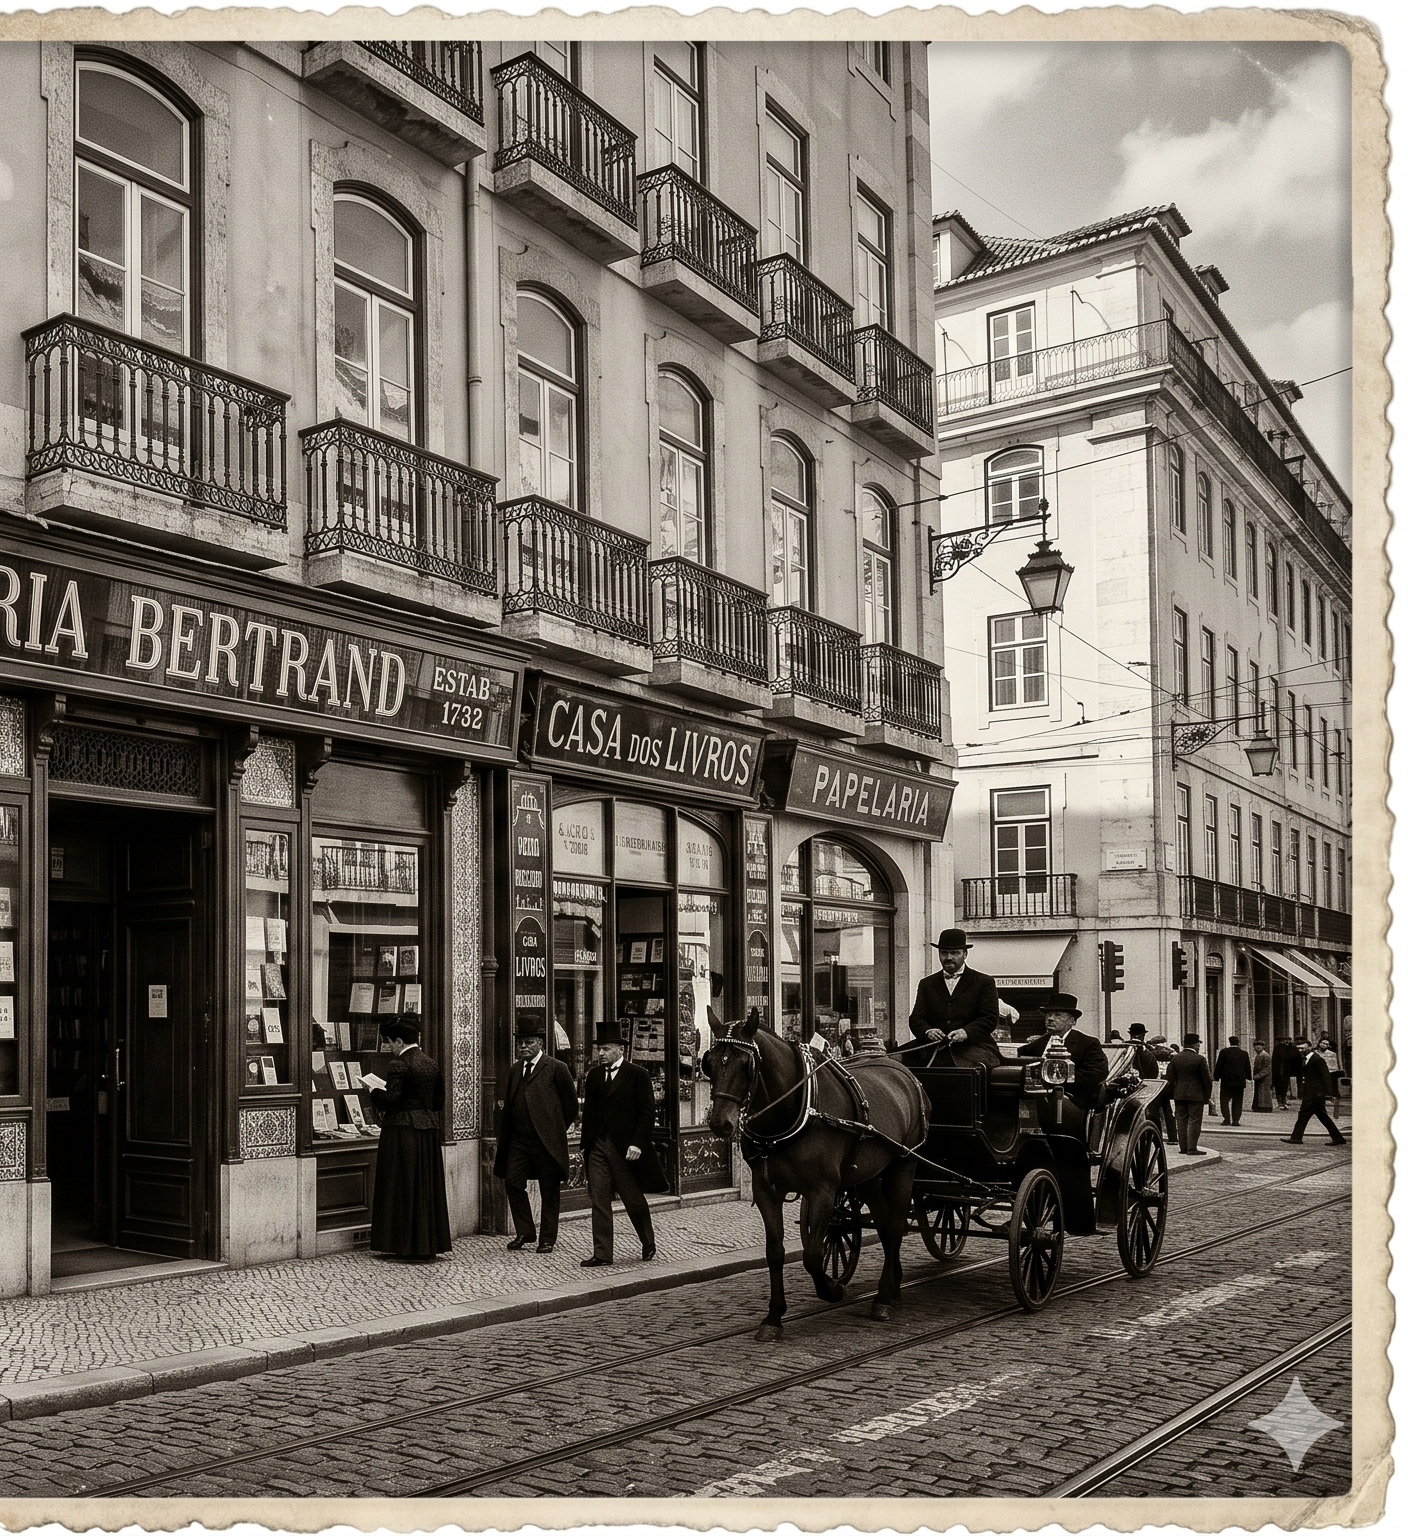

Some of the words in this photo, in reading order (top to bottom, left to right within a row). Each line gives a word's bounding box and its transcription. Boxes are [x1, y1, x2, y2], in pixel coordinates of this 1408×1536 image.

[125, 594, 407, 717] BERTRAND
[433, 667, 490, 700] ESTAB
[442, 701, 482, 729] 1732
[547, 700, 622, 761] CASA
[628, 734, 662, 766] DOS
[664, 726, 752, 785] LIVROS
[810, 764, 930, 826] PAPELARIA
